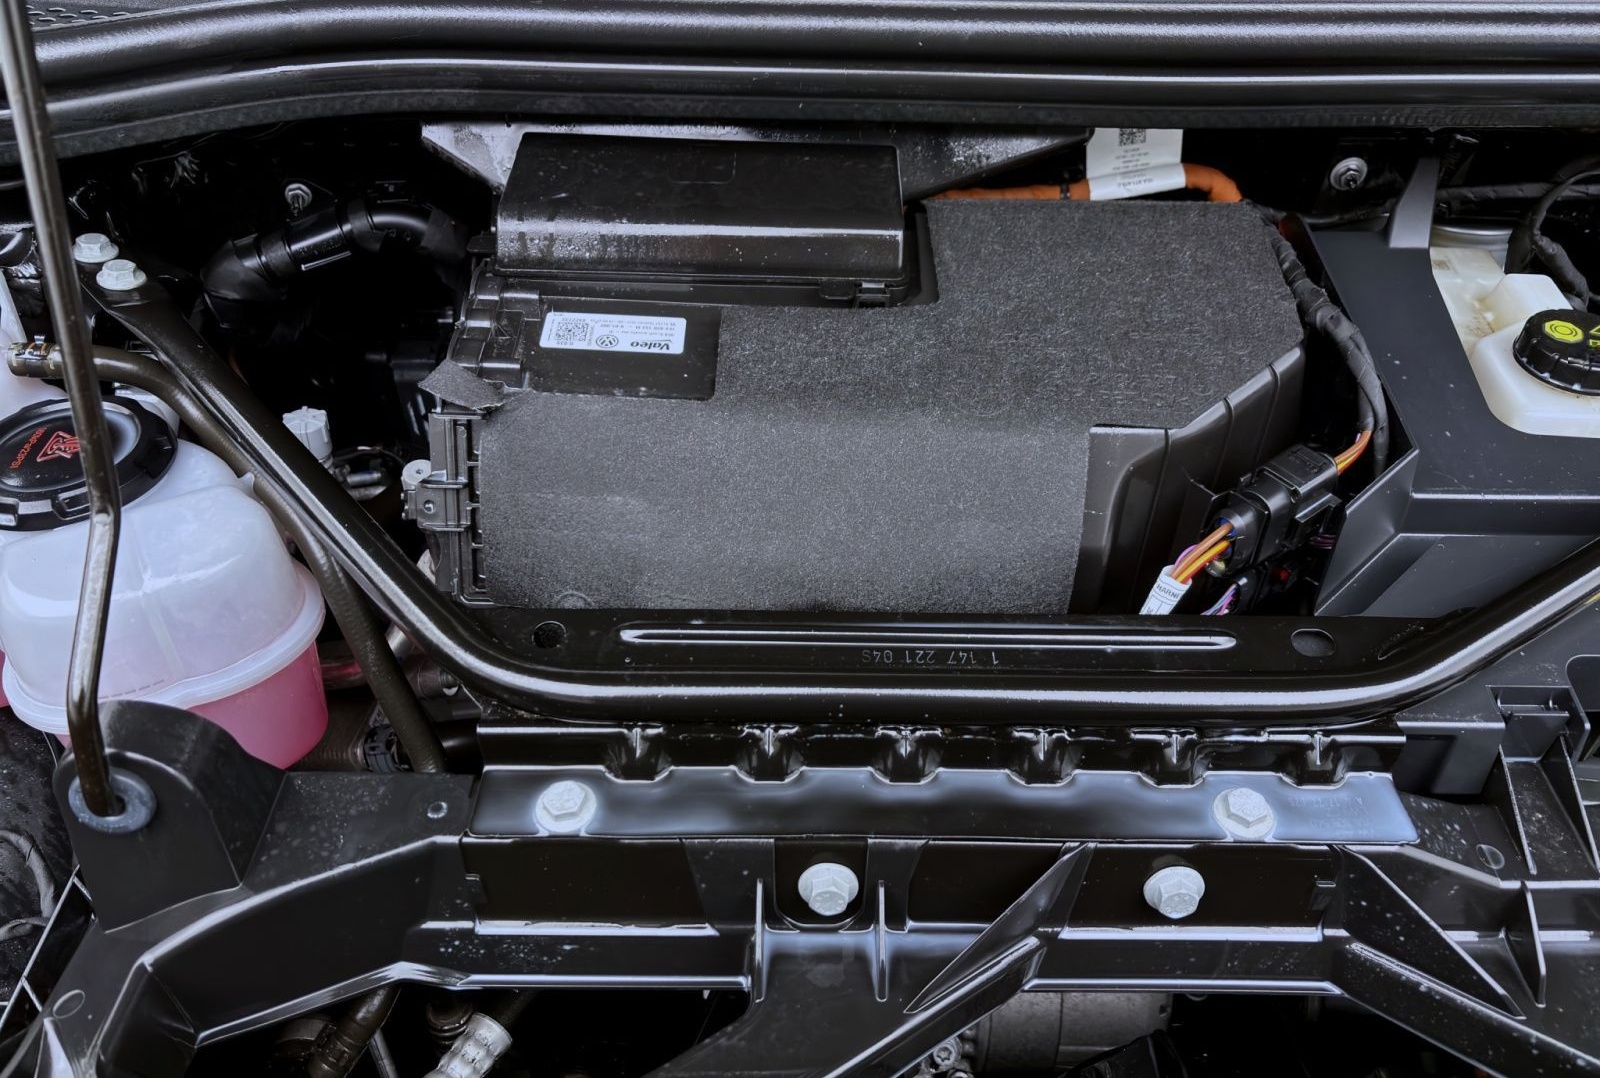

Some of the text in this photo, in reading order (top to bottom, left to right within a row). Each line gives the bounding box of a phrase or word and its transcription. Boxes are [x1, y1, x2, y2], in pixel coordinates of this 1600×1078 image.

[630, 340, 671, 351] Valeo
[905, 649, 936, 664] 221
[946, 650, 977, 665] 147
[991, 651, 999, 665] 1
